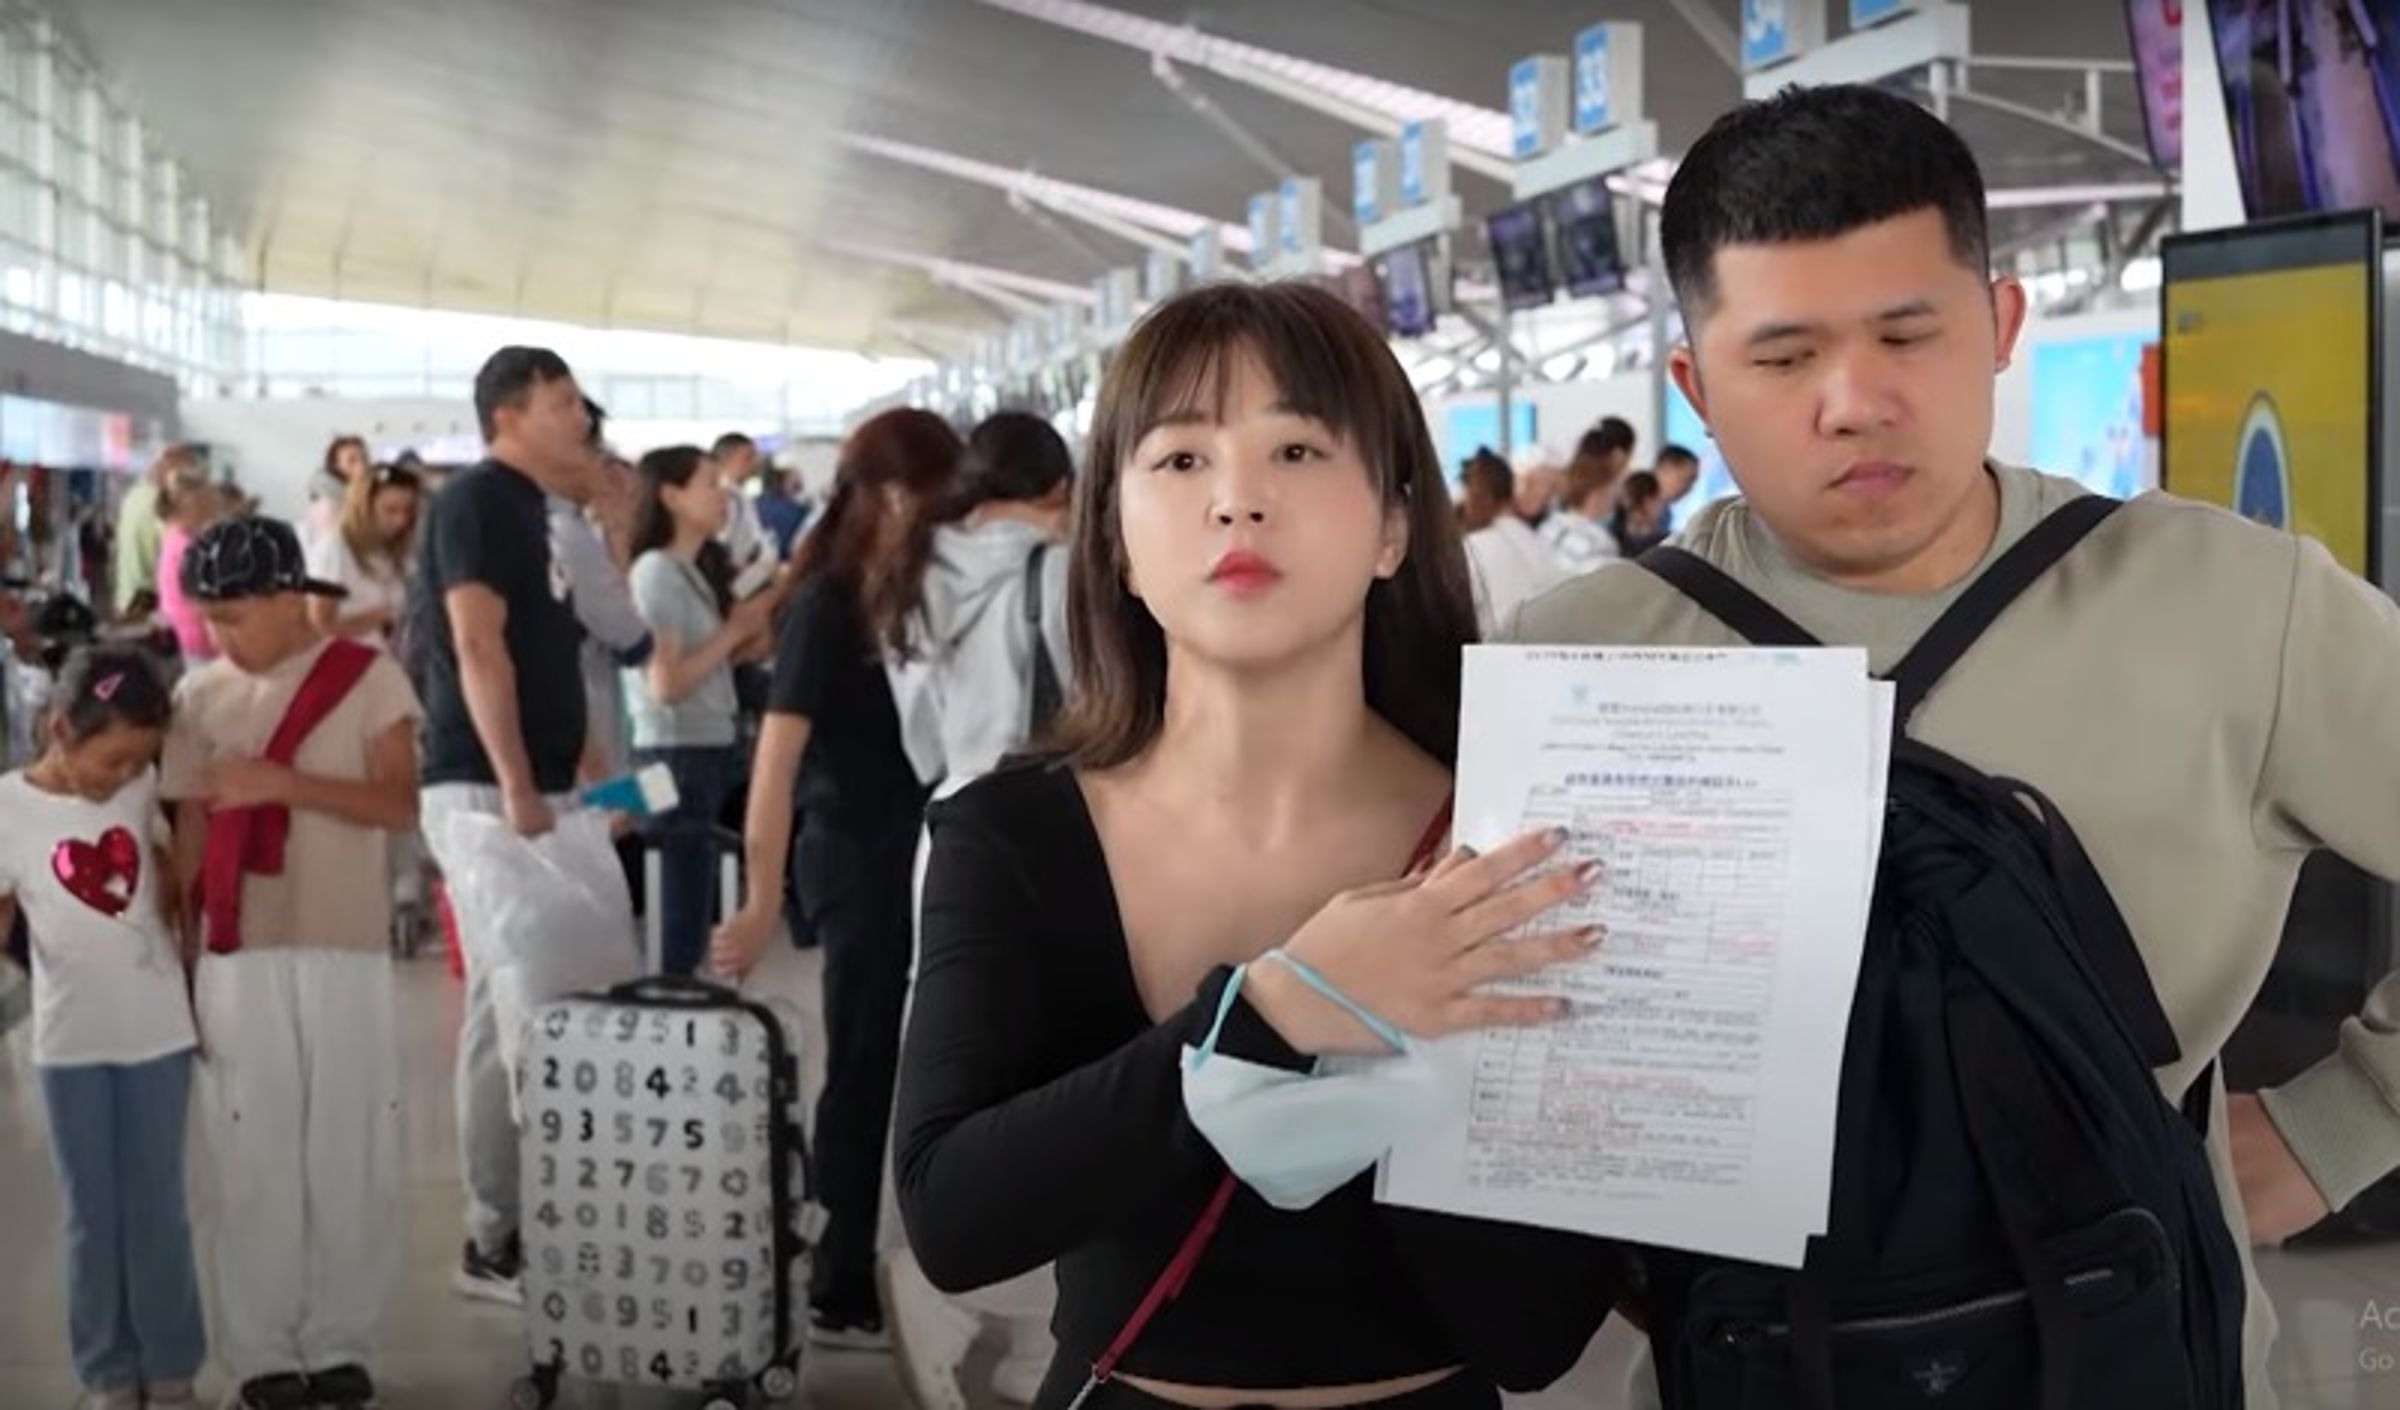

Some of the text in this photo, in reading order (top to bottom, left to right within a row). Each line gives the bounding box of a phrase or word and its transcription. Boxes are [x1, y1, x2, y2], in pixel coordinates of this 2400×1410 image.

[616, 1010, 640, 1042] 9
[685, 1019, 697, 1048] 1
[720, 1019, 739, 1056] 3
[542, 1055, 561, 1090] 2
[574, 1059, 598, 1094] 0
[614, 1059, 635, 1098] 8
[645, 1064, 672, 1101] 4
[714, 1071, 747, 1105] 4
[540, 1108, 563, 1144] 9
[578, 1107, 595, 1143] 3
[614, 1110, 634, 1144] 5
[646, 1117, 670, 1148] 7
[683, 1117, 705, 1150] 5
[539, 1153, 557, 1187] 3
[577, 1156, 598, 1189] 2
[614, 1158, 636, 1188] 7
[645, 1161, 670, 1196] 6
[679, 1164, 703, 1194] 7
[536, 1200, 564, 1230] 4
[575, 1201, 598, 1229] 0
[646, 1204, 669, 1239] 8
[723, 1210, 746, 1240] 2
[616, 1244, 634, 1280] 3
[649, 1255, 670, 1285] 7
[681, 1259, 708, 1288] 0
[721, 1258, 749, 1292] 9
[543, 1290, 567, 1323] 0
[616, 1294, 639, 1328] 9
[687, 1304, 698, 1335] 1
[721, 1300, 741, 1337] 3
[581, 1343, 603, 1374] 0
[649, 1349, 673, 1382] 4
